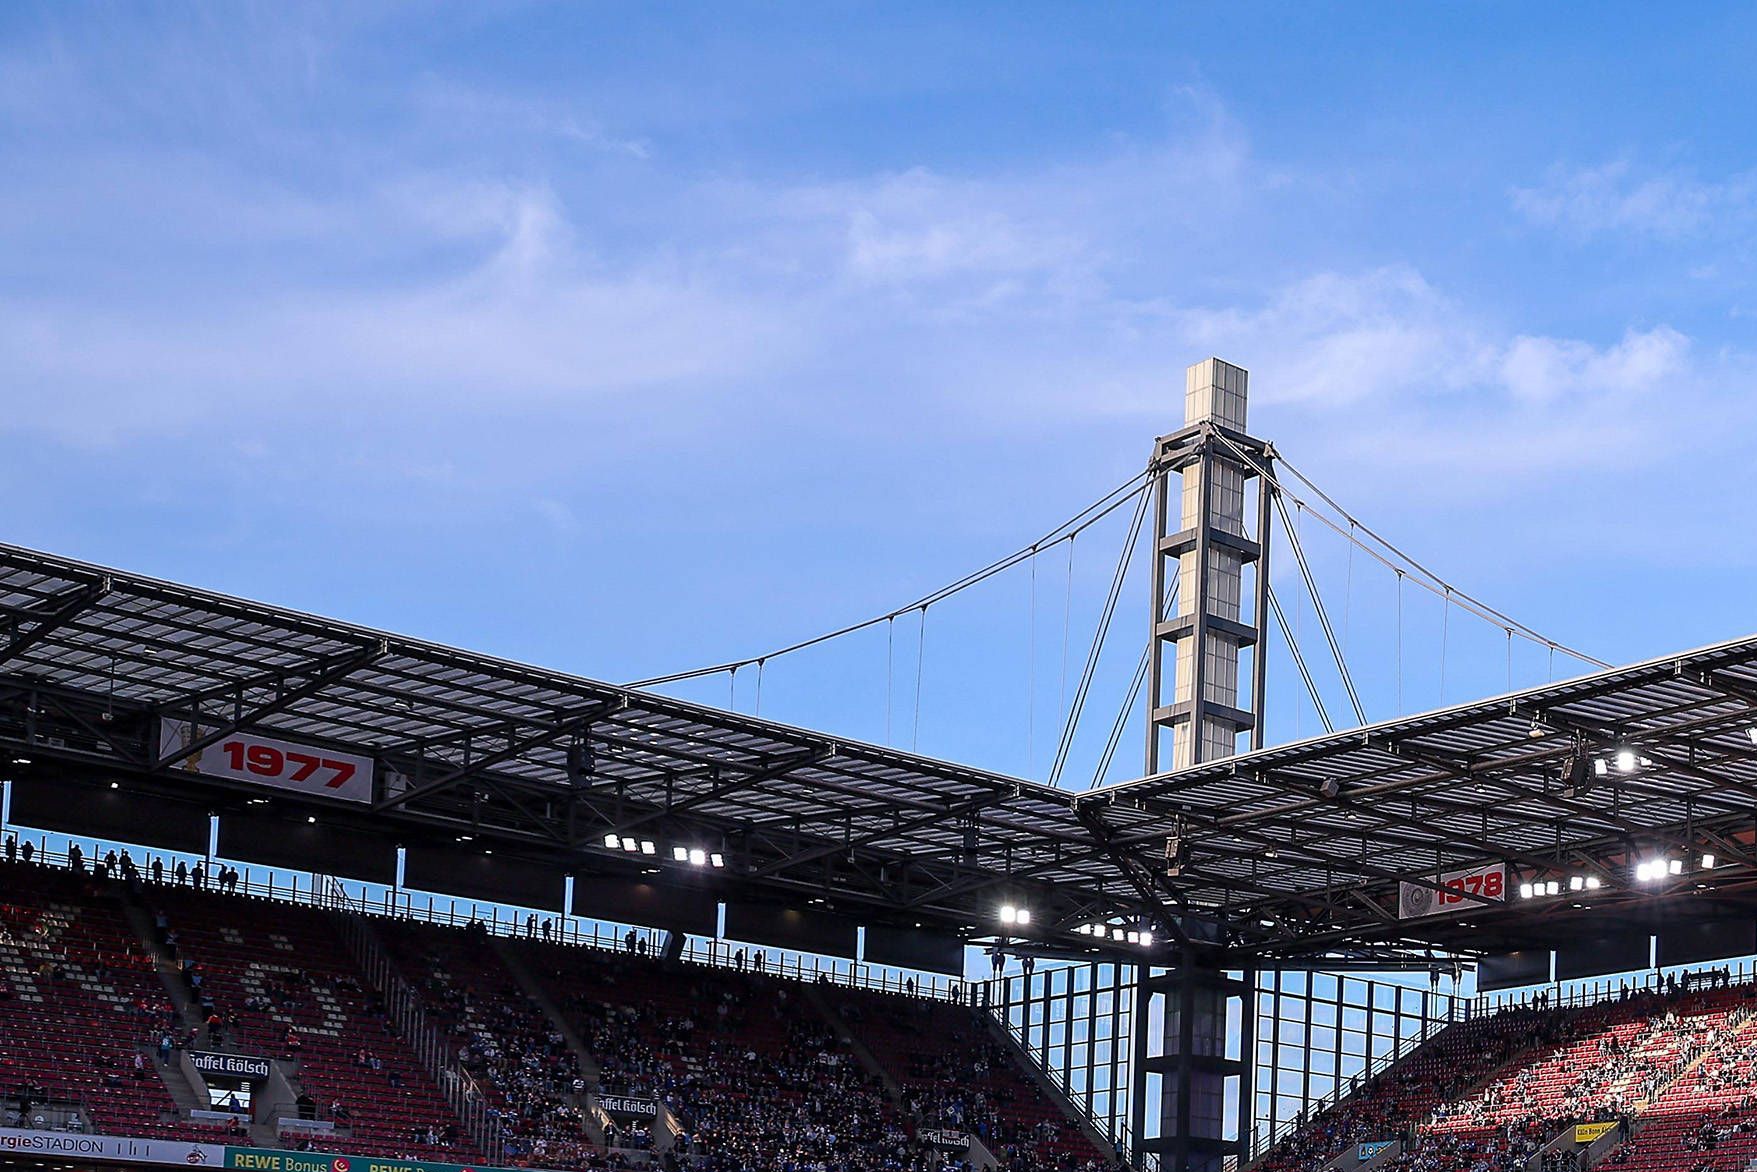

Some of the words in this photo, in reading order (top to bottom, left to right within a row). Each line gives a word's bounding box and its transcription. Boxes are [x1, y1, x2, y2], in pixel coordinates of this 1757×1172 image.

[223, 741, 356, 789] 1977
[1436, 872, 1503, 905] 1978
[226, 1058, 268, 1076] Kölsch
[623, 1100, 656, 1115] Kölsch
[234, 1153, 280, 1170] REWE
